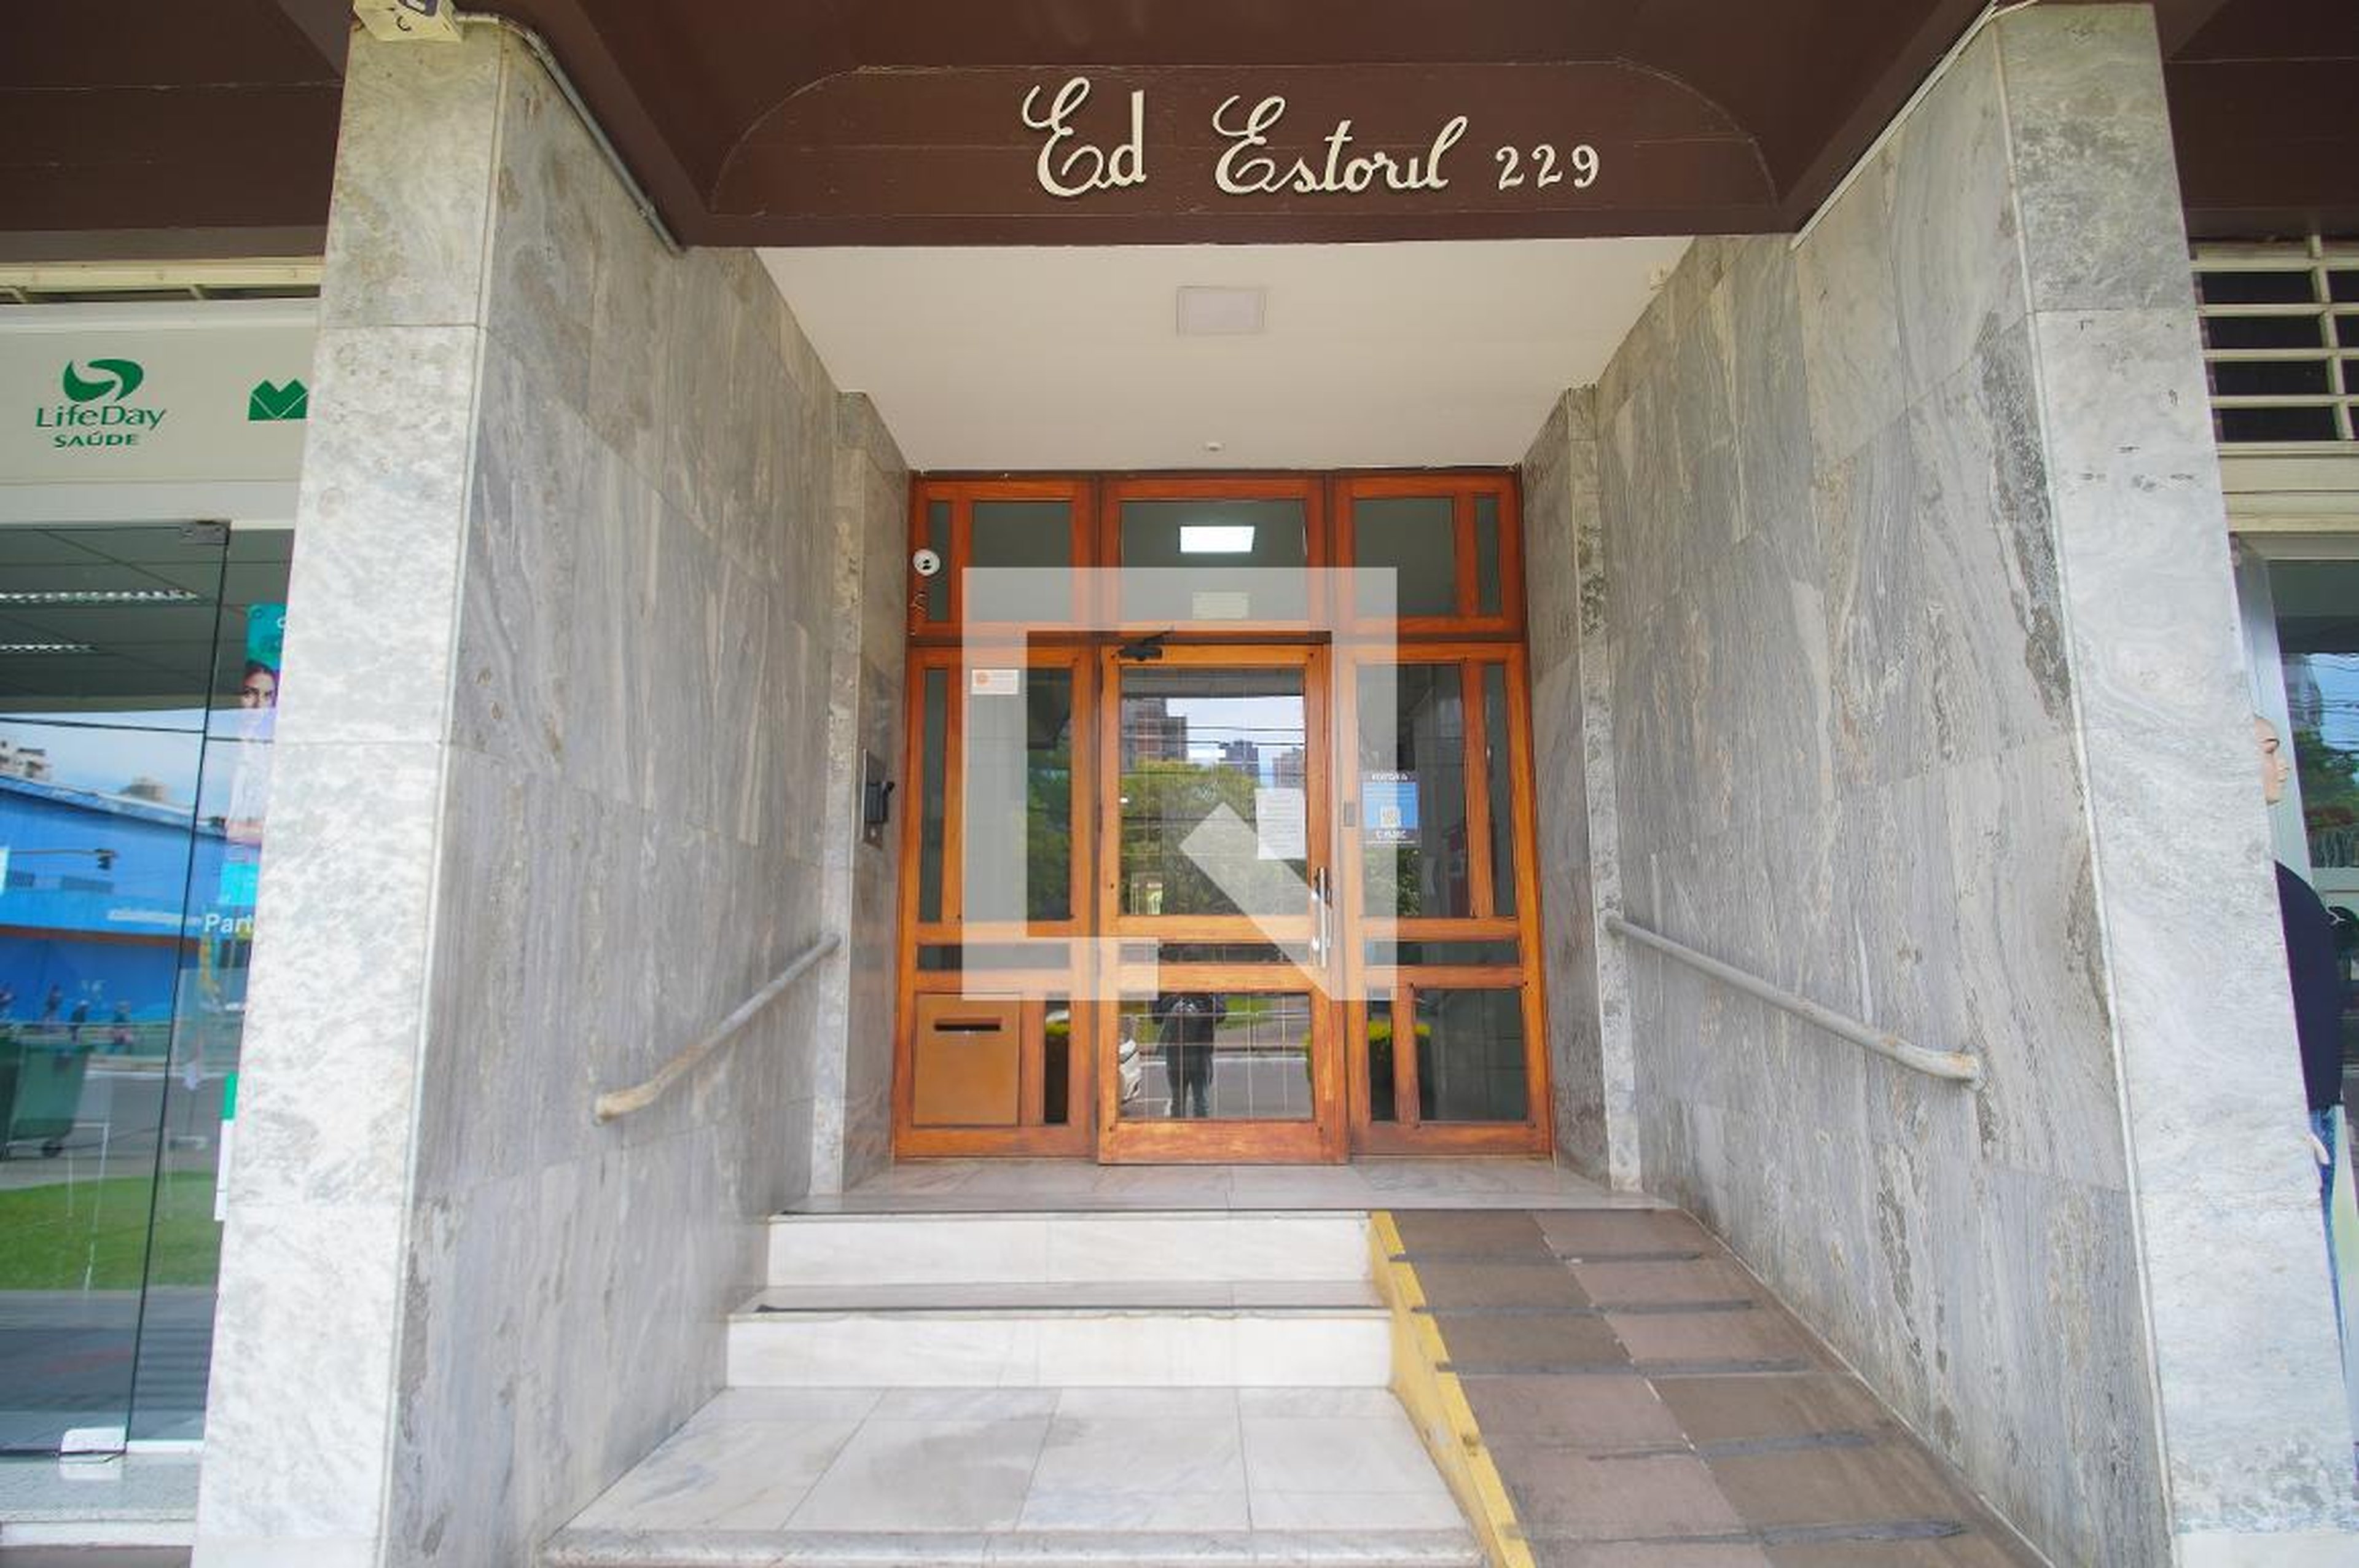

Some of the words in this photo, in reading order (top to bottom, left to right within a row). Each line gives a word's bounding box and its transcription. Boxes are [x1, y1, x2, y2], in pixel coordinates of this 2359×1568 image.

[1022, 77, 1148, 197] Ed
[1213, 95, 1468, 194] Estoril
[1496, 145, 1599, 190] 229
[36, 404, 166, 431] LifeDay
[53, 431, 139, 448] SAÚDE
